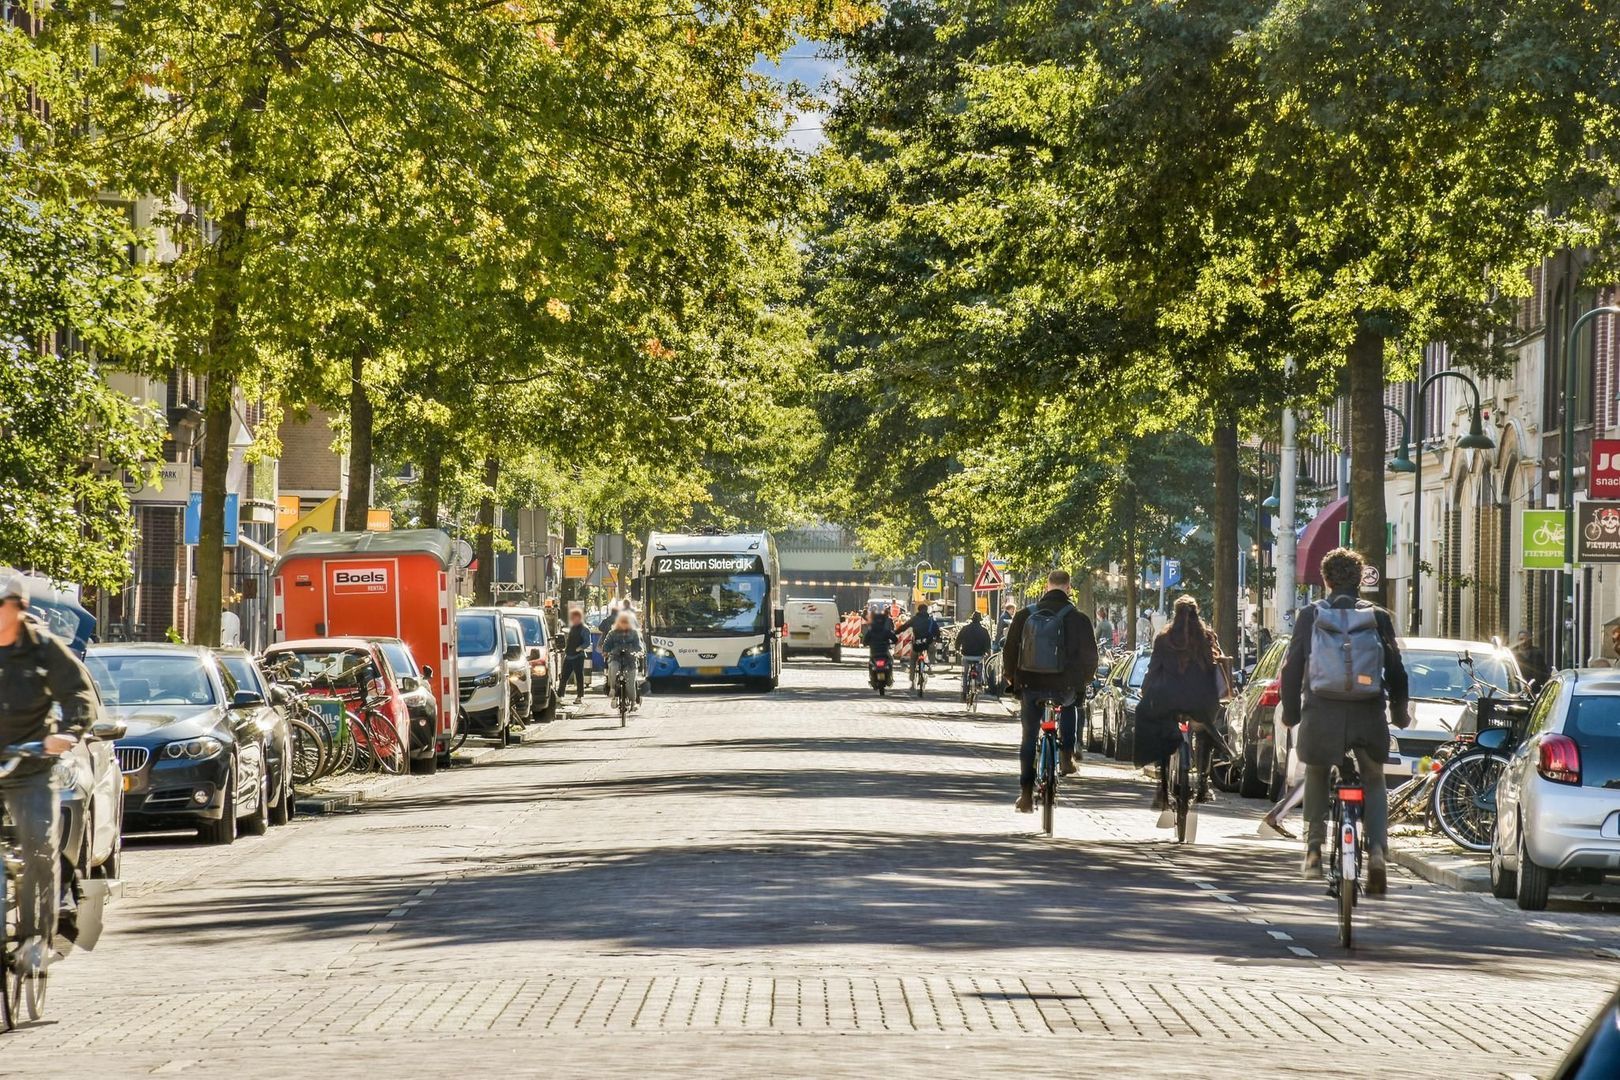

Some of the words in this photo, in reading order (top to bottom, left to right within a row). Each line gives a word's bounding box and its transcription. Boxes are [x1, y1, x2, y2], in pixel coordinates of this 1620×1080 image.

[1596, 477, 1620, 486] snac
[1524, 550, 1564, 558] FIETSPIR
[659, 559, 673, 573] 22
[674, 558, 707, 571] Station
[708, 558, 753, 571] Sloterdijk
[336, 571, 385, 583] Boels
